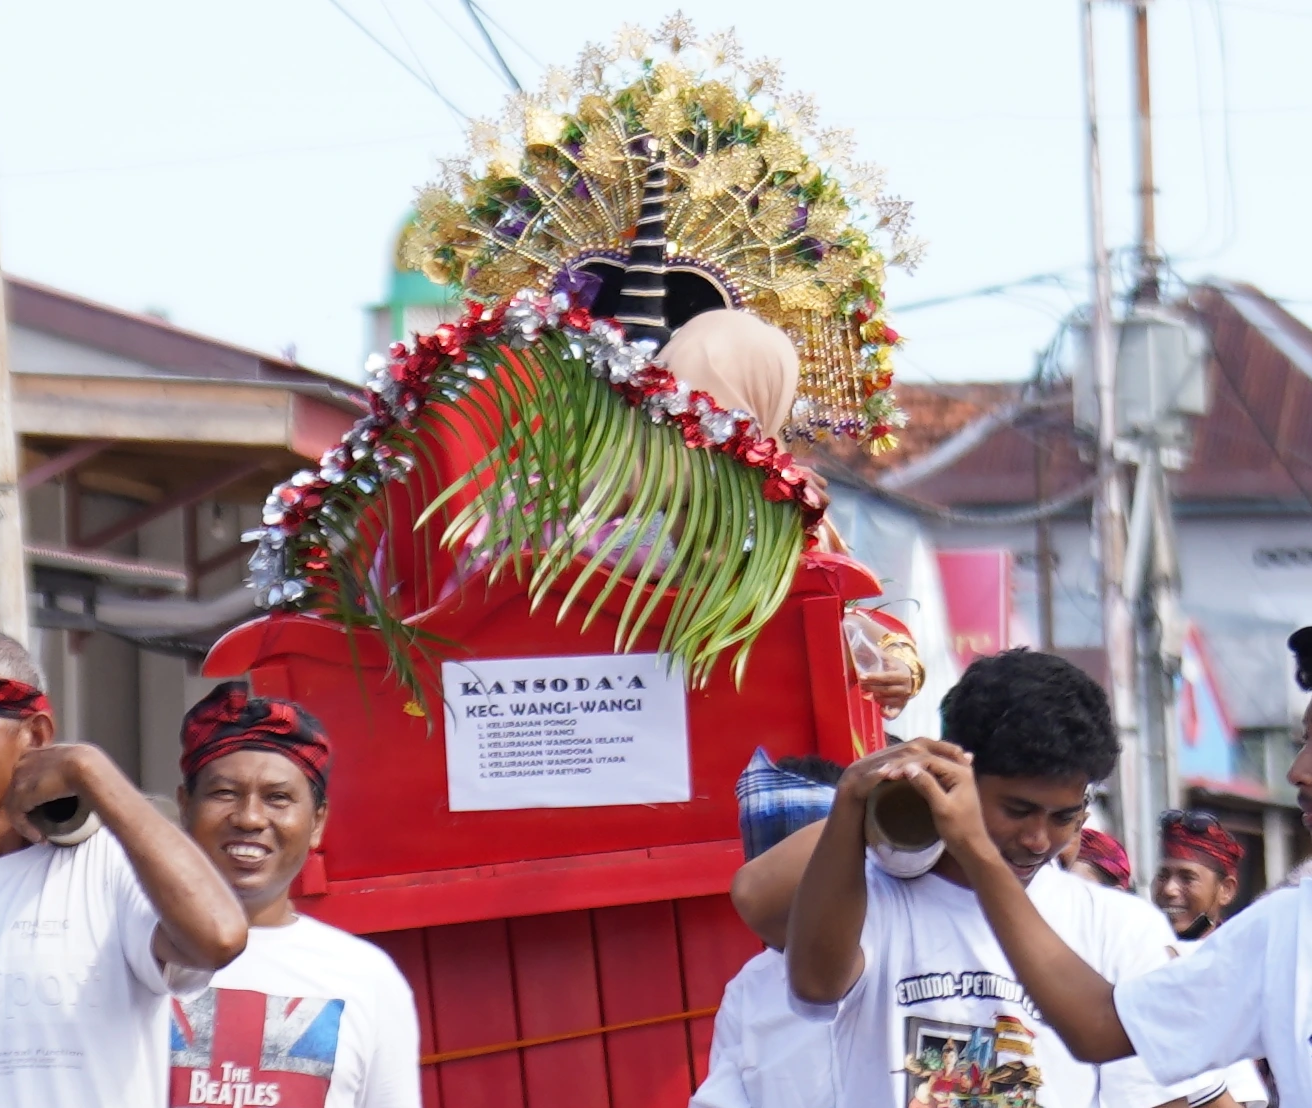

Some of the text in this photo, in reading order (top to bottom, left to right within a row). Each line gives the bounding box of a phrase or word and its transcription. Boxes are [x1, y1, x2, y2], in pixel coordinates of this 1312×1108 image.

[459, 675, 647, 697] KANSODA'A
[465, 699, 643, 718] KEC. WANGI-WANGI
